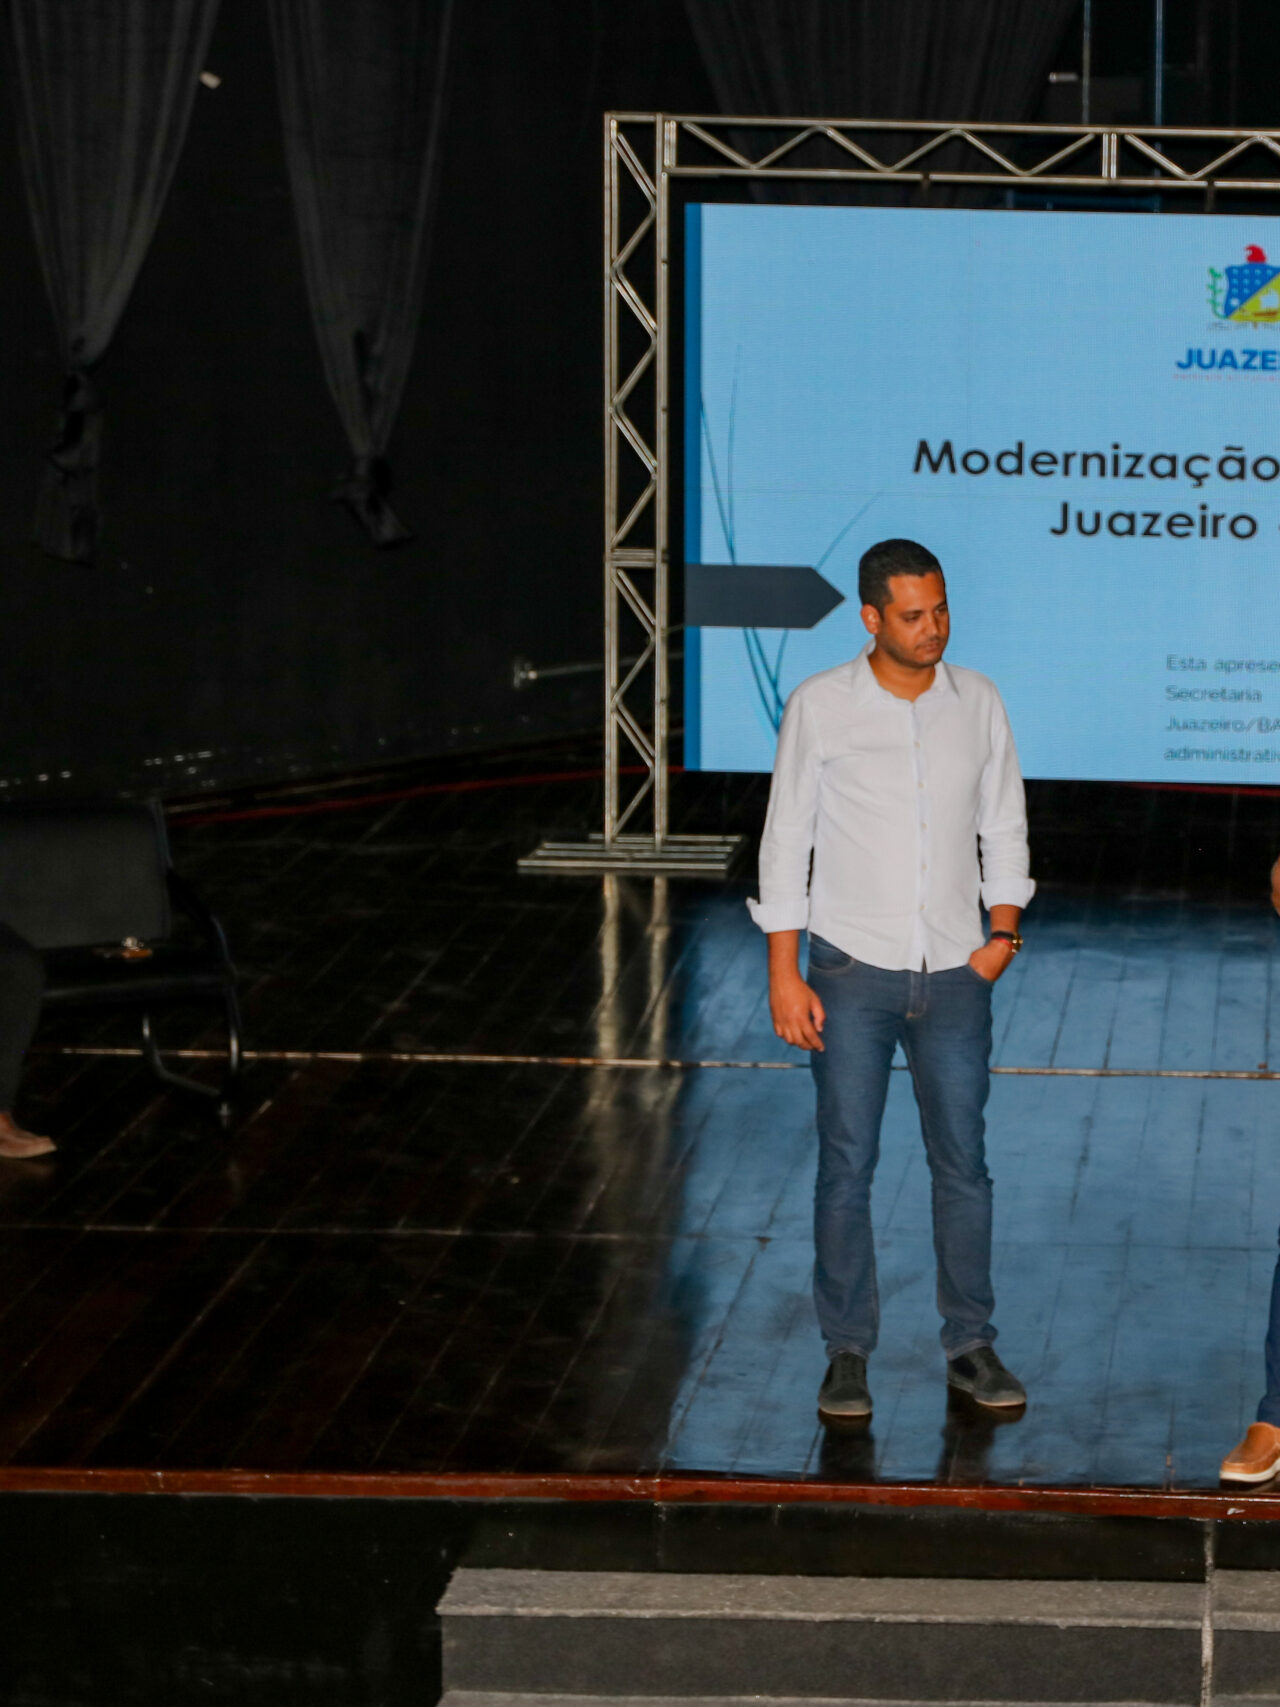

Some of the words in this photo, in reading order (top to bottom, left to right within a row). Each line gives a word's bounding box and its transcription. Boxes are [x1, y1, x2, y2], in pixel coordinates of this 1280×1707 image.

[1050, 502, 1258, 540] Juazeiro
[1166, 654, 1207, 671] Esta
[1165, 685, 1263, 702] Secretaria
